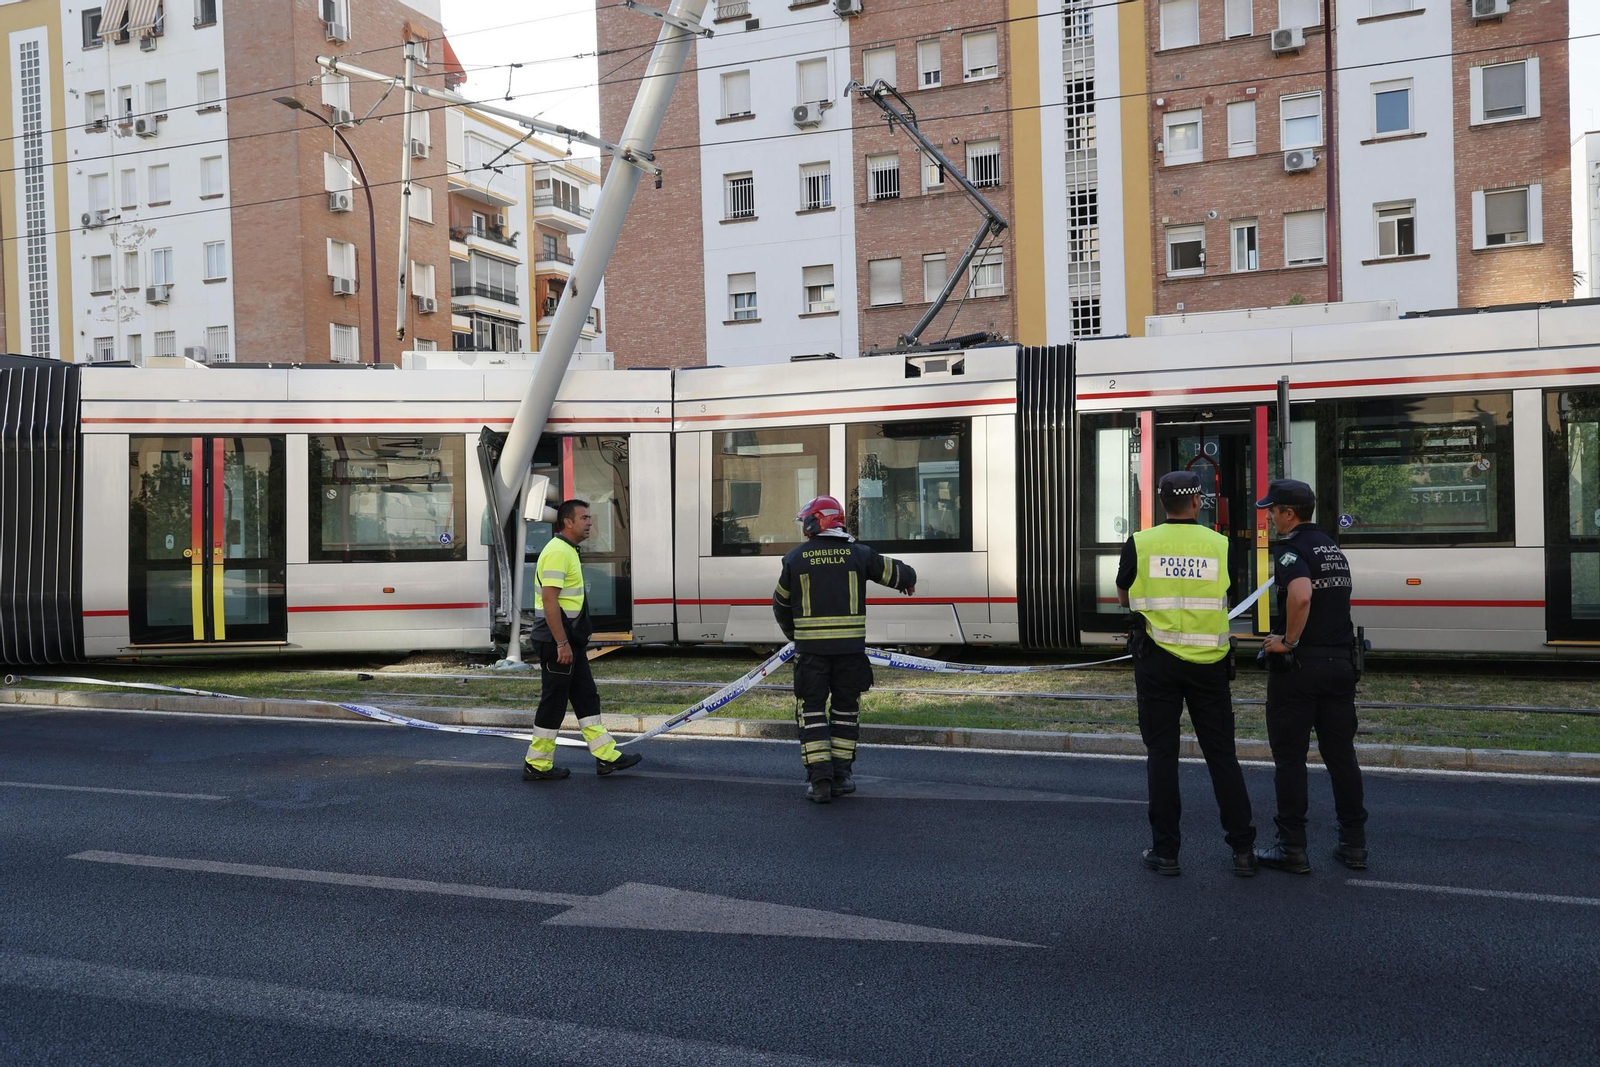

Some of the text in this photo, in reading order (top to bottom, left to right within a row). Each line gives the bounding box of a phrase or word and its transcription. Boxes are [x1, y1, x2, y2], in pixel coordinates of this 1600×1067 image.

[802, 548, 852, 559] BOMBEROS
[810, 556, 846, 566] SEVILLA
[1160, 557, 1208, 569] POLICIA
[1165, 567, 1202, 578] LOCAL
[1320, 562, 1349, 572] SEVILLA
